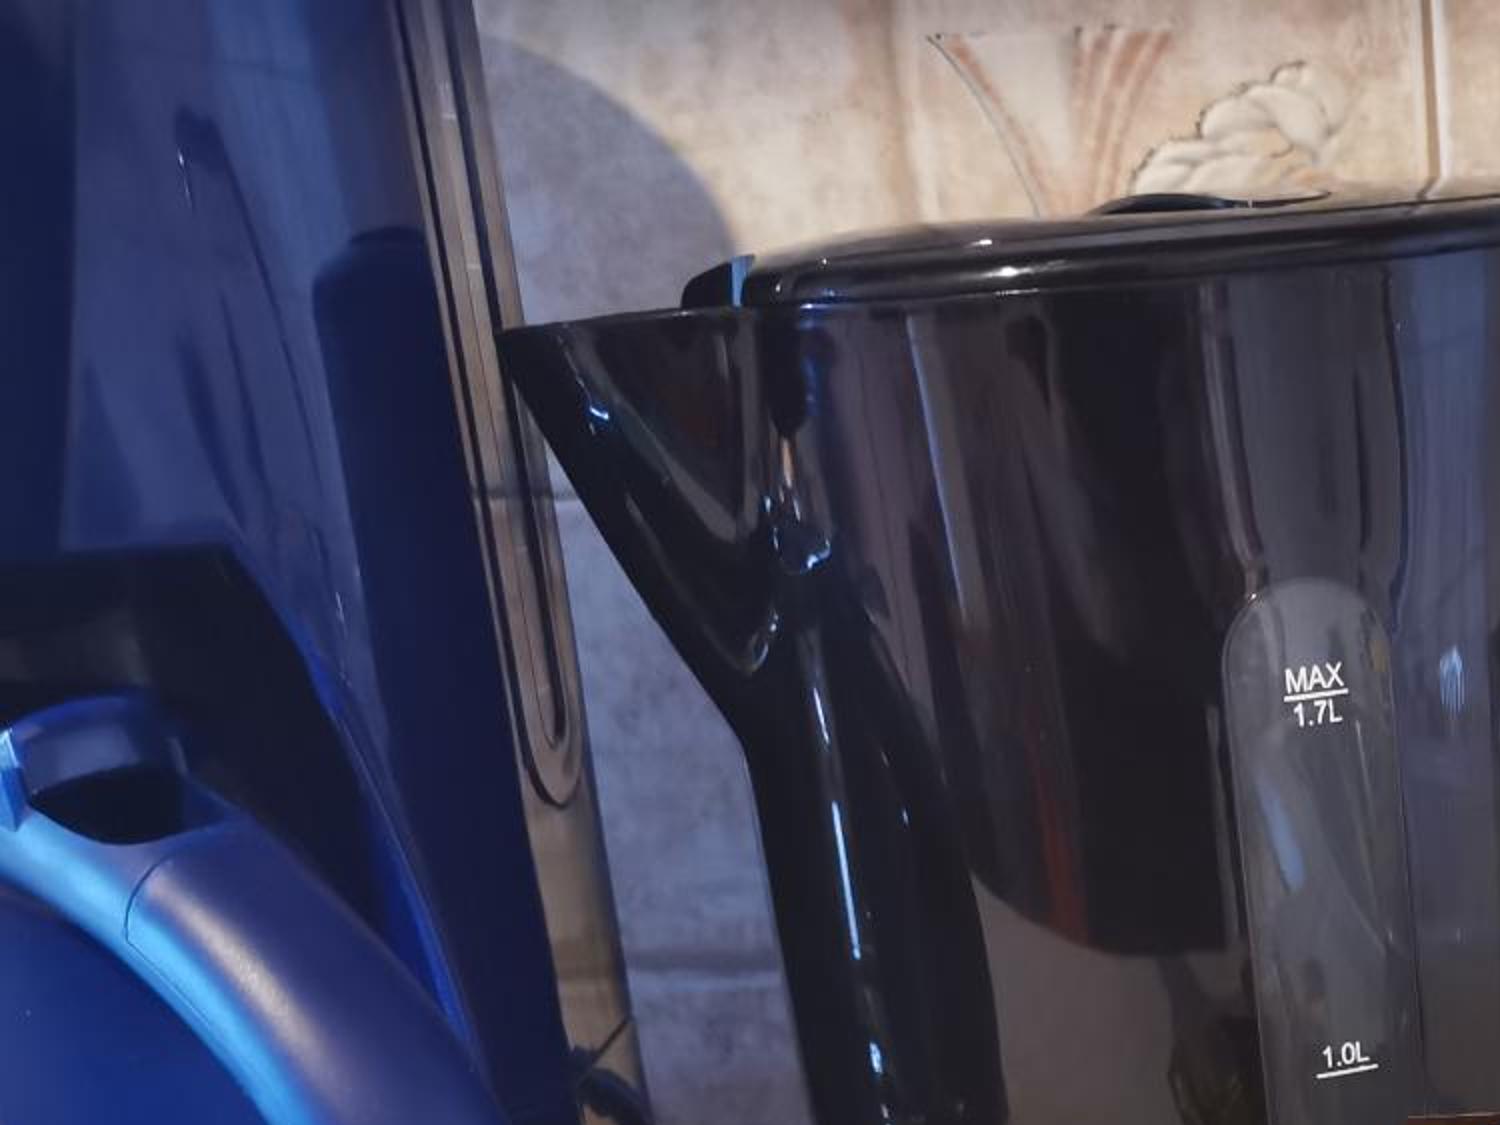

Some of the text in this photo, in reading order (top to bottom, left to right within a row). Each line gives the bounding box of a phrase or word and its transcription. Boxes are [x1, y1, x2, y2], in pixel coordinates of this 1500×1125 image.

[1284, 662, 1344, 694] MAX
[1294, 699, 1343, 728] 1.7L
[1322, 1041, 1371, 1069] 1.0L
